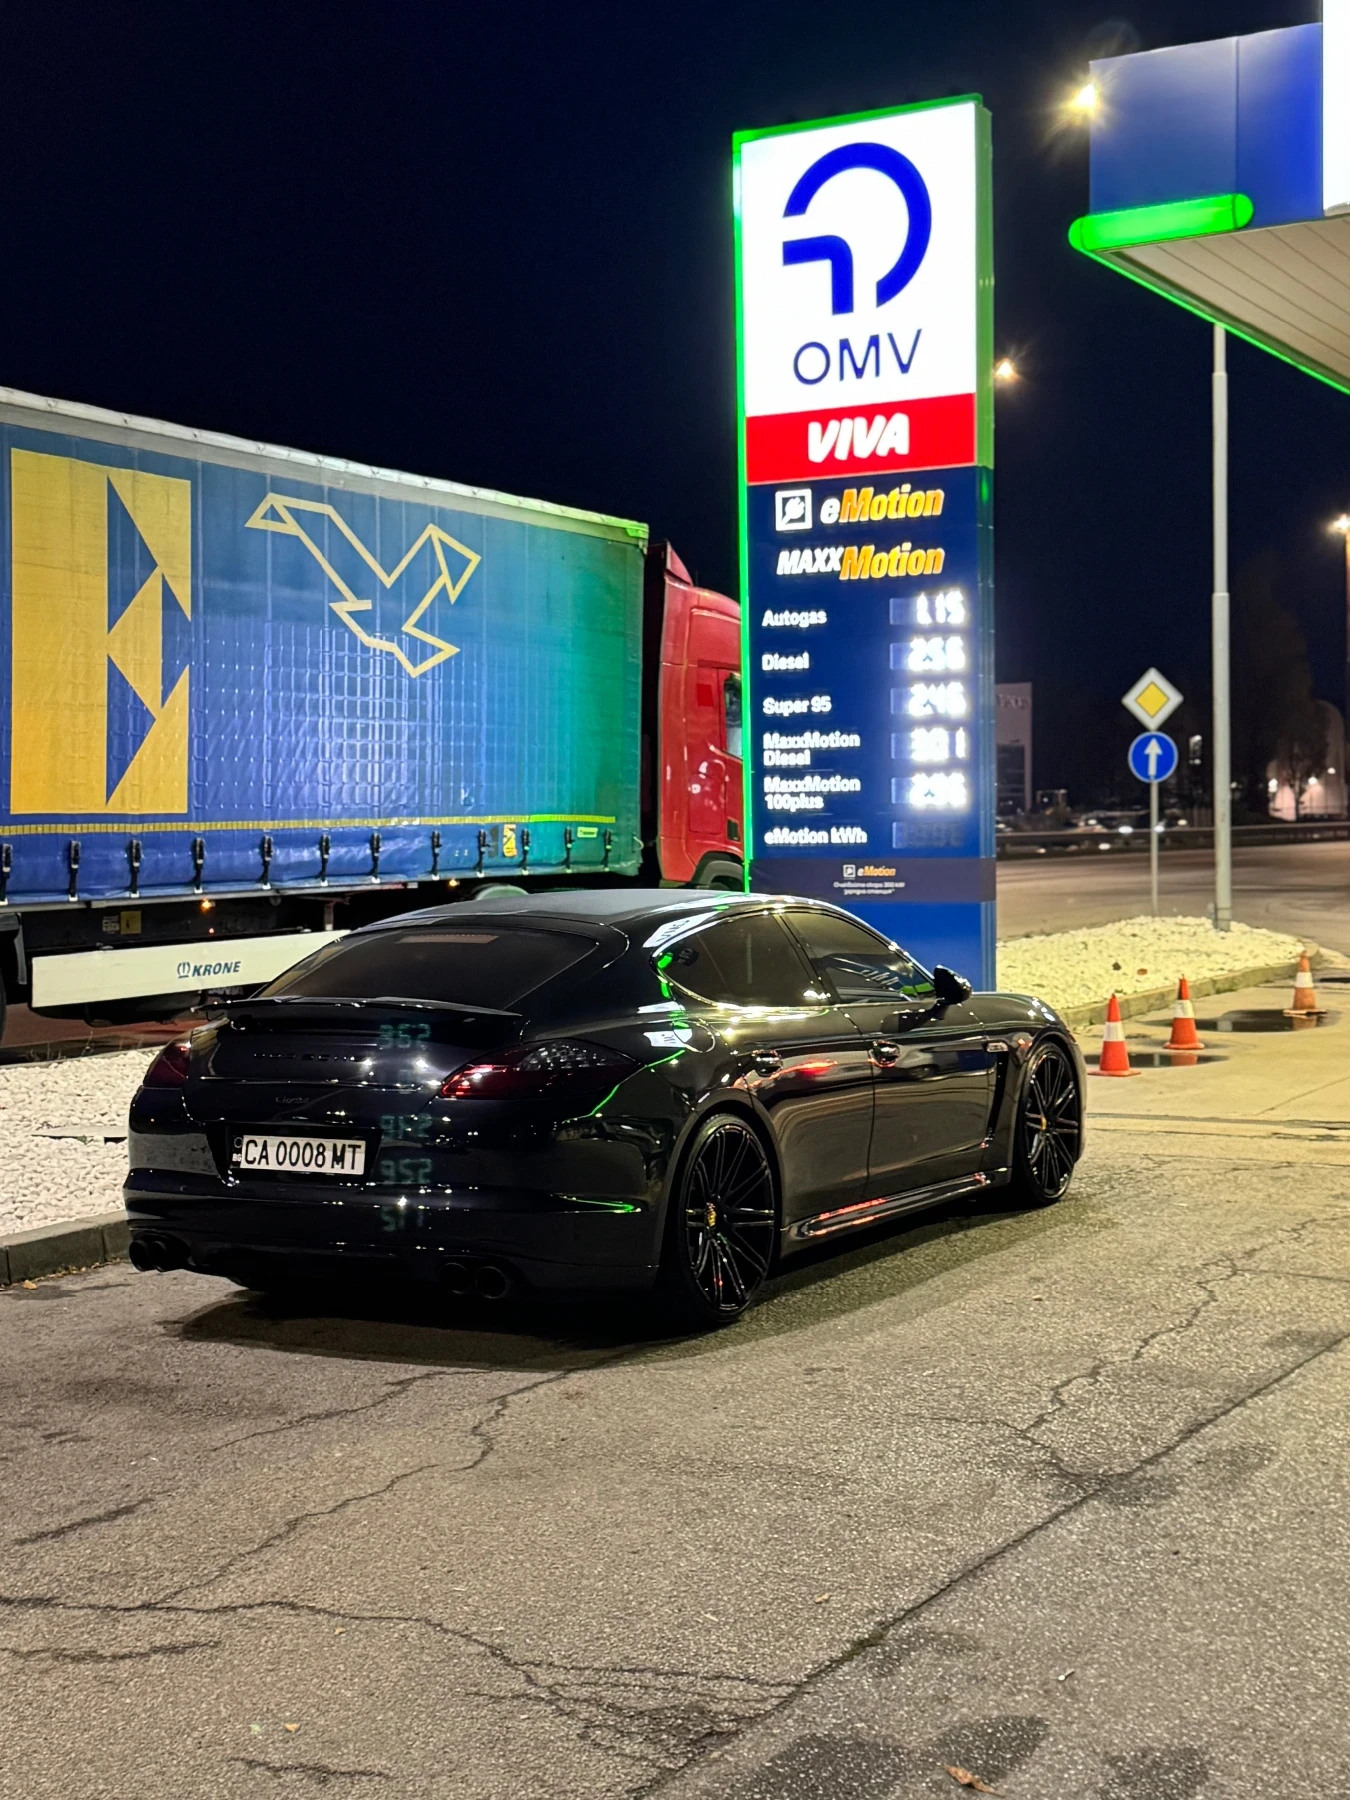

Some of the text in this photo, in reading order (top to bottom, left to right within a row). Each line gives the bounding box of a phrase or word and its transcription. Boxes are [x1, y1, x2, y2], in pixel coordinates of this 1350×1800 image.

[794, 328, 922, 385] OMV
[808, 412, 910, 463] VIVA
[820, 484, 945, 524] eMotion
[776, 542, 945, 580] MAXXMotion
[762, 609, 828, 628] Autogas
[762, 651, 810, 671] Diesel
[762, 695, 832, 716] Super 95
[763, 731, 861, 749] MaxxMotion
[763, 749, 811, 766] Diesel
[763, 775, 861, 793] MaxxMotion
[765, 793, 825, 812] 100plus
[764, 826, 868, 844] eMotion kWh
[192, 961, 241, 977] KRONE
[244, 1139, 362, 1170] CA 0008 MT
